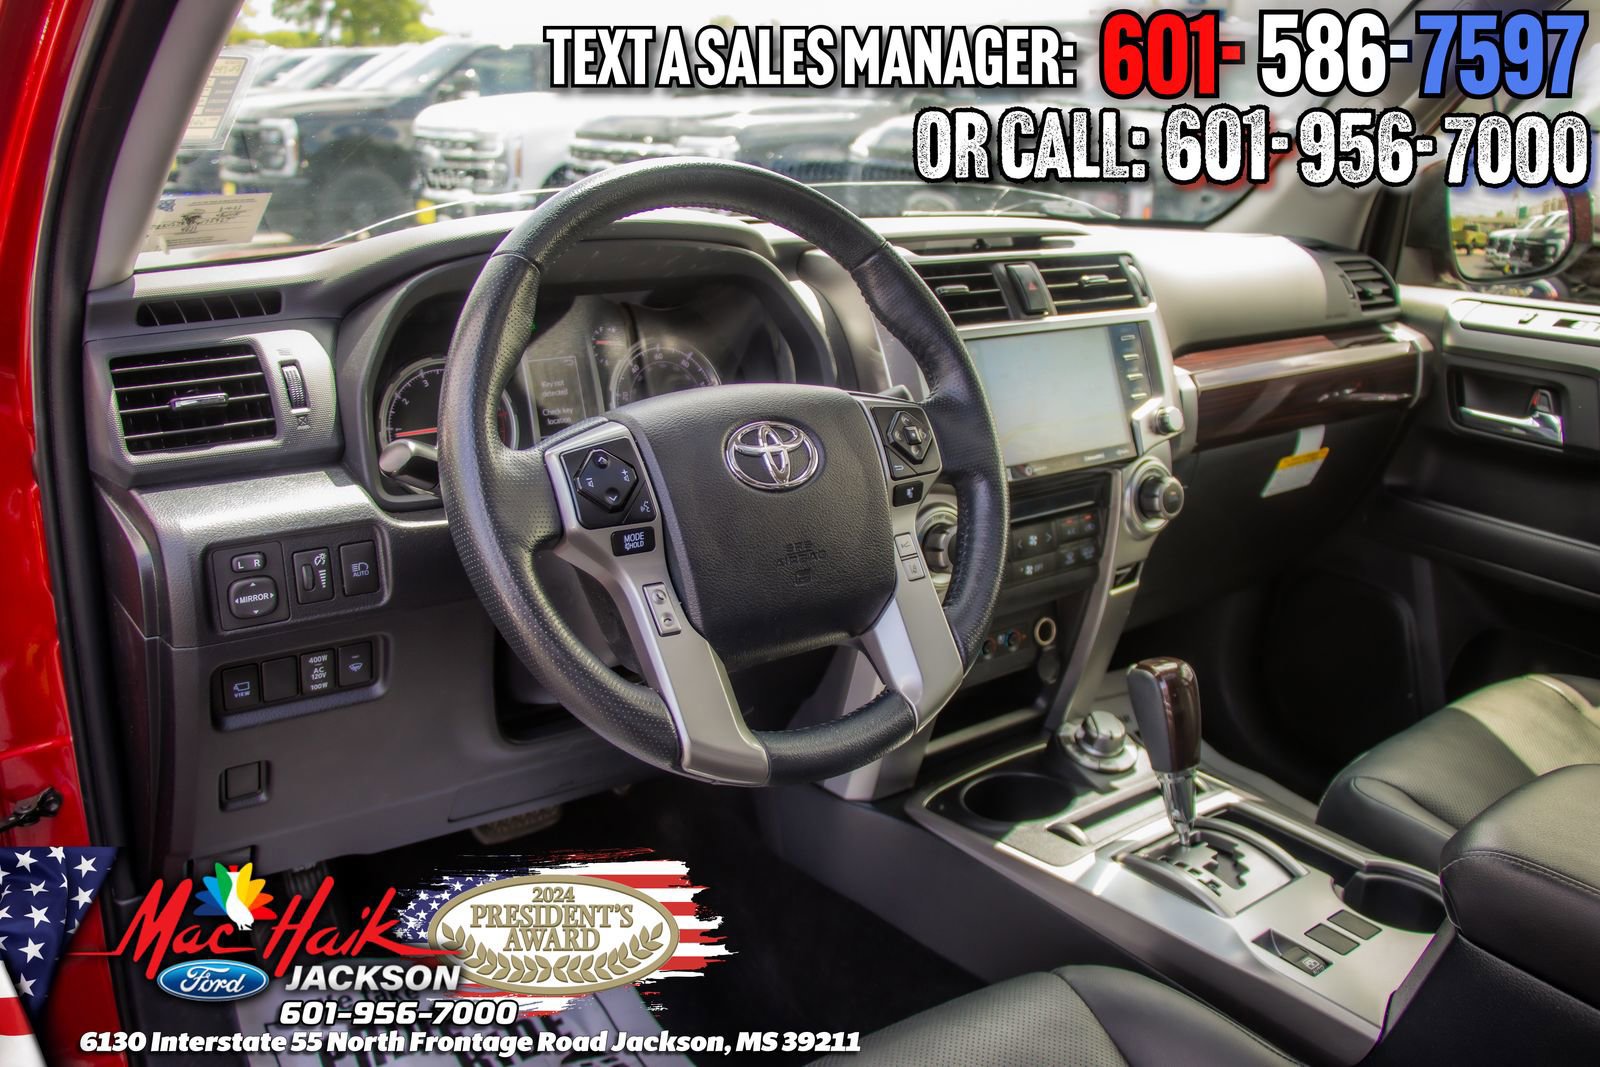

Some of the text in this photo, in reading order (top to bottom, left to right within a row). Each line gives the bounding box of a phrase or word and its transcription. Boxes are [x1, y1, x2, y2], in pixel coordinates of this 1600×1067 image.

[422, 379, 430, 388] 3
[401, 397, 411, 406] 2
[542, 407, 573, 416] Check key
[547, 417, 571, 425] location
[624, 531, 645, 543] MODE
[629, 540, 645, 549] HOLD
[237, 561, 244, 570] L
[254, 559, 262, 568] R
[353, 569, 370, 578] AUTO
[239, 592, 269, 604] MIRROR
[308, 654, 328, 665] 400W
[313, 666, 324, 674] AC
[311, 671, 327, 680] 120V
[310, 681, 328, 691] 100W
[234, 690, 250, 699] VIEW
